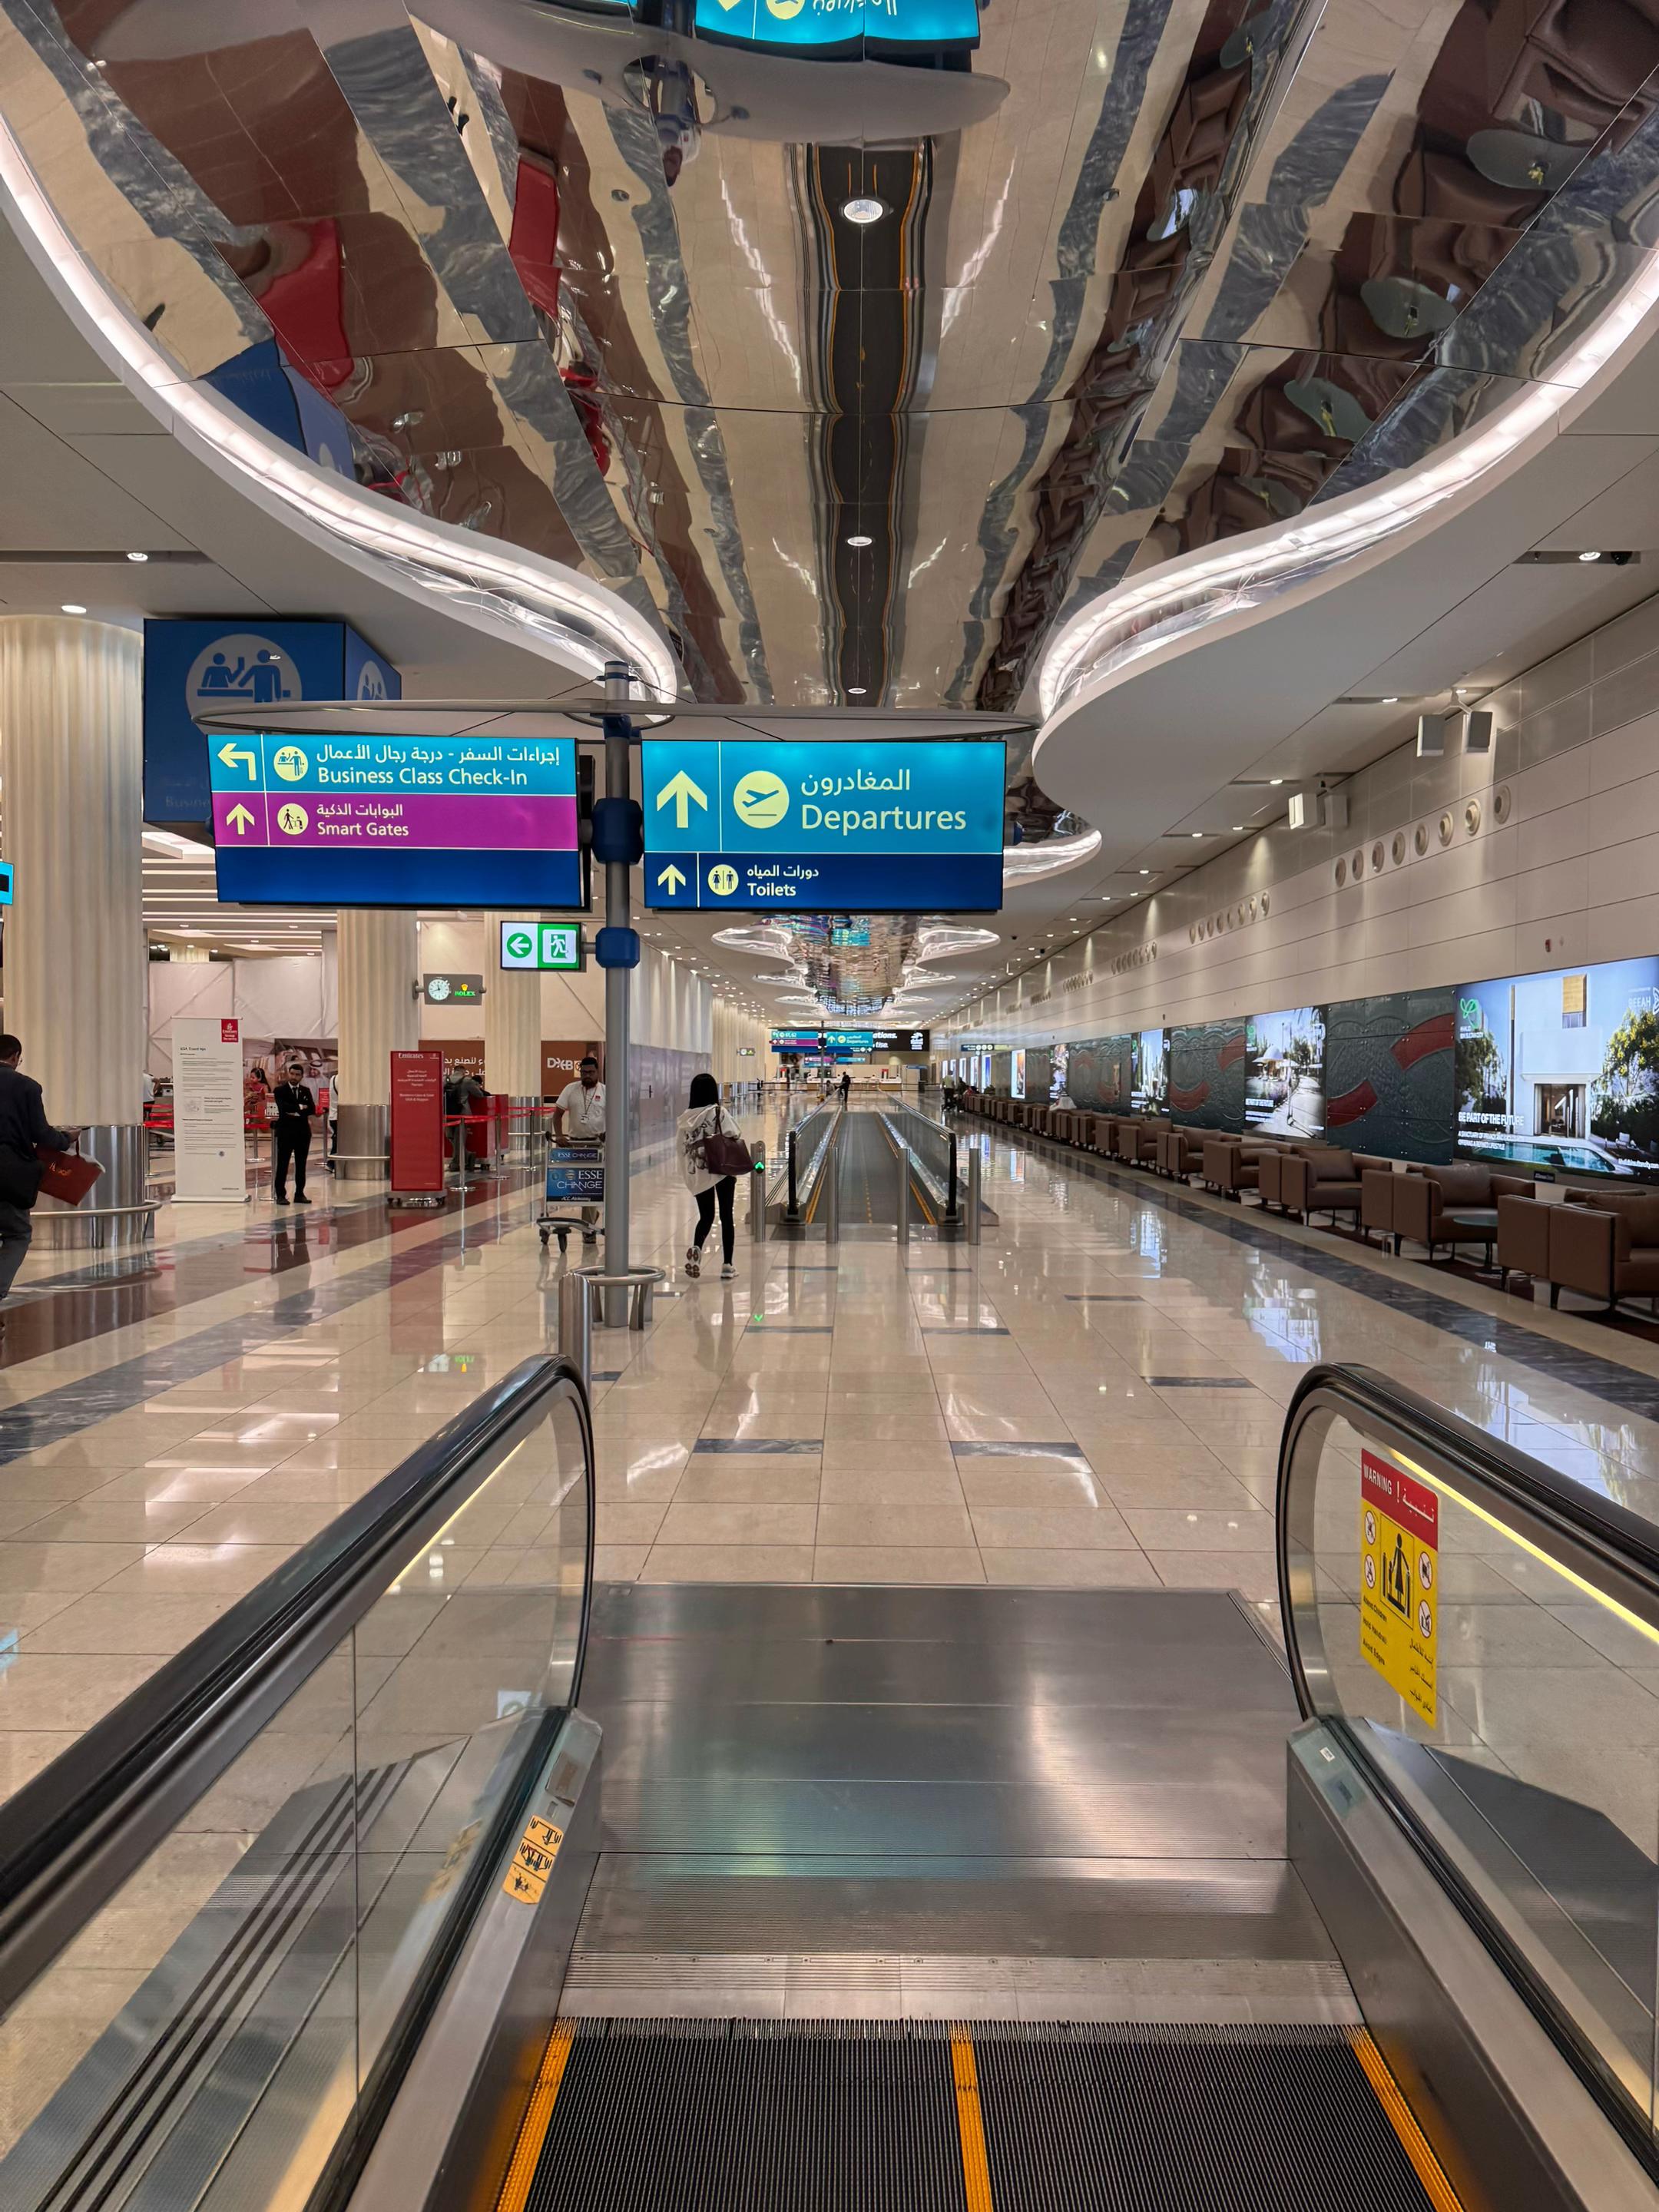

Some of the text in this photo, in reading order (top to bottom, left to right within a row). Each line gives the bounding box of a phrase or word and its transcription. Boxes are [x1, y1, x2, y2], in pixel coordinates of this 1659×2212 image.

[316, 743, 370, 763] الأعمال
[375, 744, 406, 763] رجال
[411, 747, 443, 763] درجة
[459, 746, 502, 764] السفر
[507, 746, 559, 766] إجراءات
[318, 767, 528, 785] Business Class Check-In
[800, 768, 910, 796] المغادرون
[316, 803, 403, 819] البوابات الذكية
[802, 803, 967, 836] Departures
[317, 821, 409, 836] Smart Gates
[747, 864, 820, 879] دورات المياه
[747, 882, 796, 896] Toilets
[1459, 1111, 1525, 1126] BE PART OF THE FUTURE
[578, 1170, 603, 1180] ESSE
[556, 1181, 603, 1192] CHANGE
[1363, 1463, 1392, 1495] WARNING
